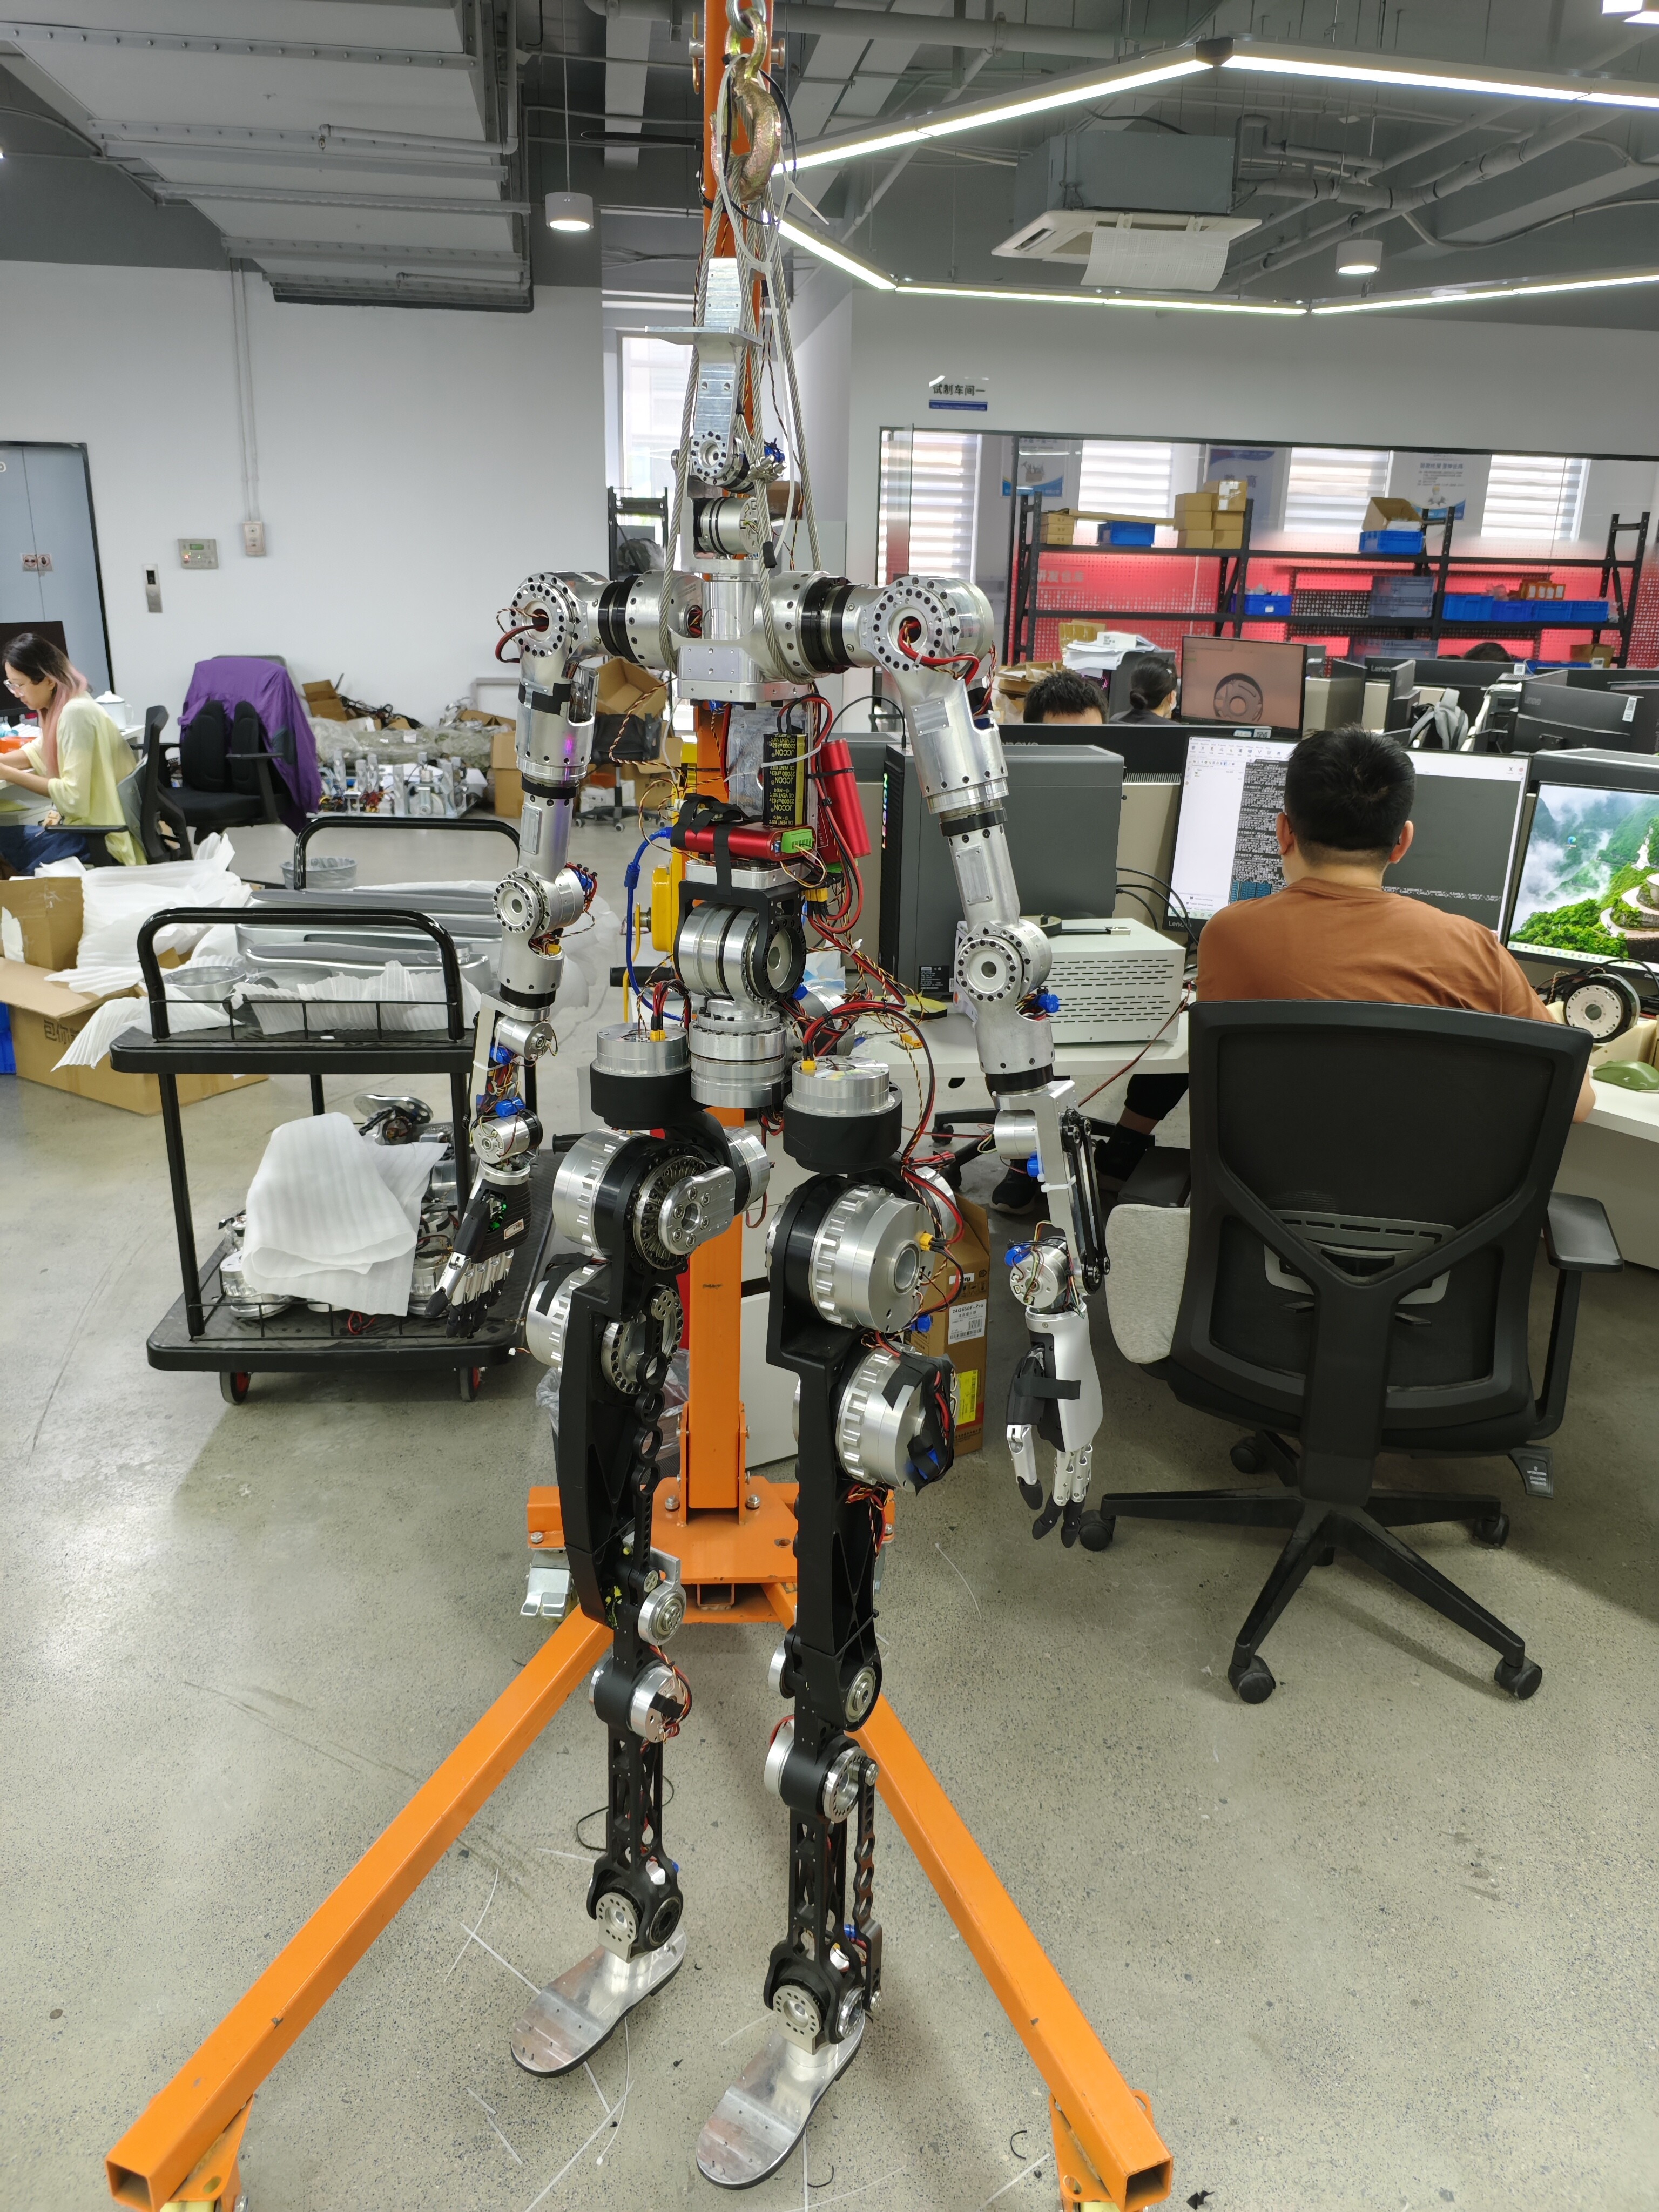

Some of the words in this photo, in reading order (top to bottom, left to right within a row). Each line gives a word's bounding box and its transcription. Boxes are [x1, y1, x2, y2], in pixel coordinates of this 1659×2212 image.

[933, 383, 986, 396] 试制车间一
